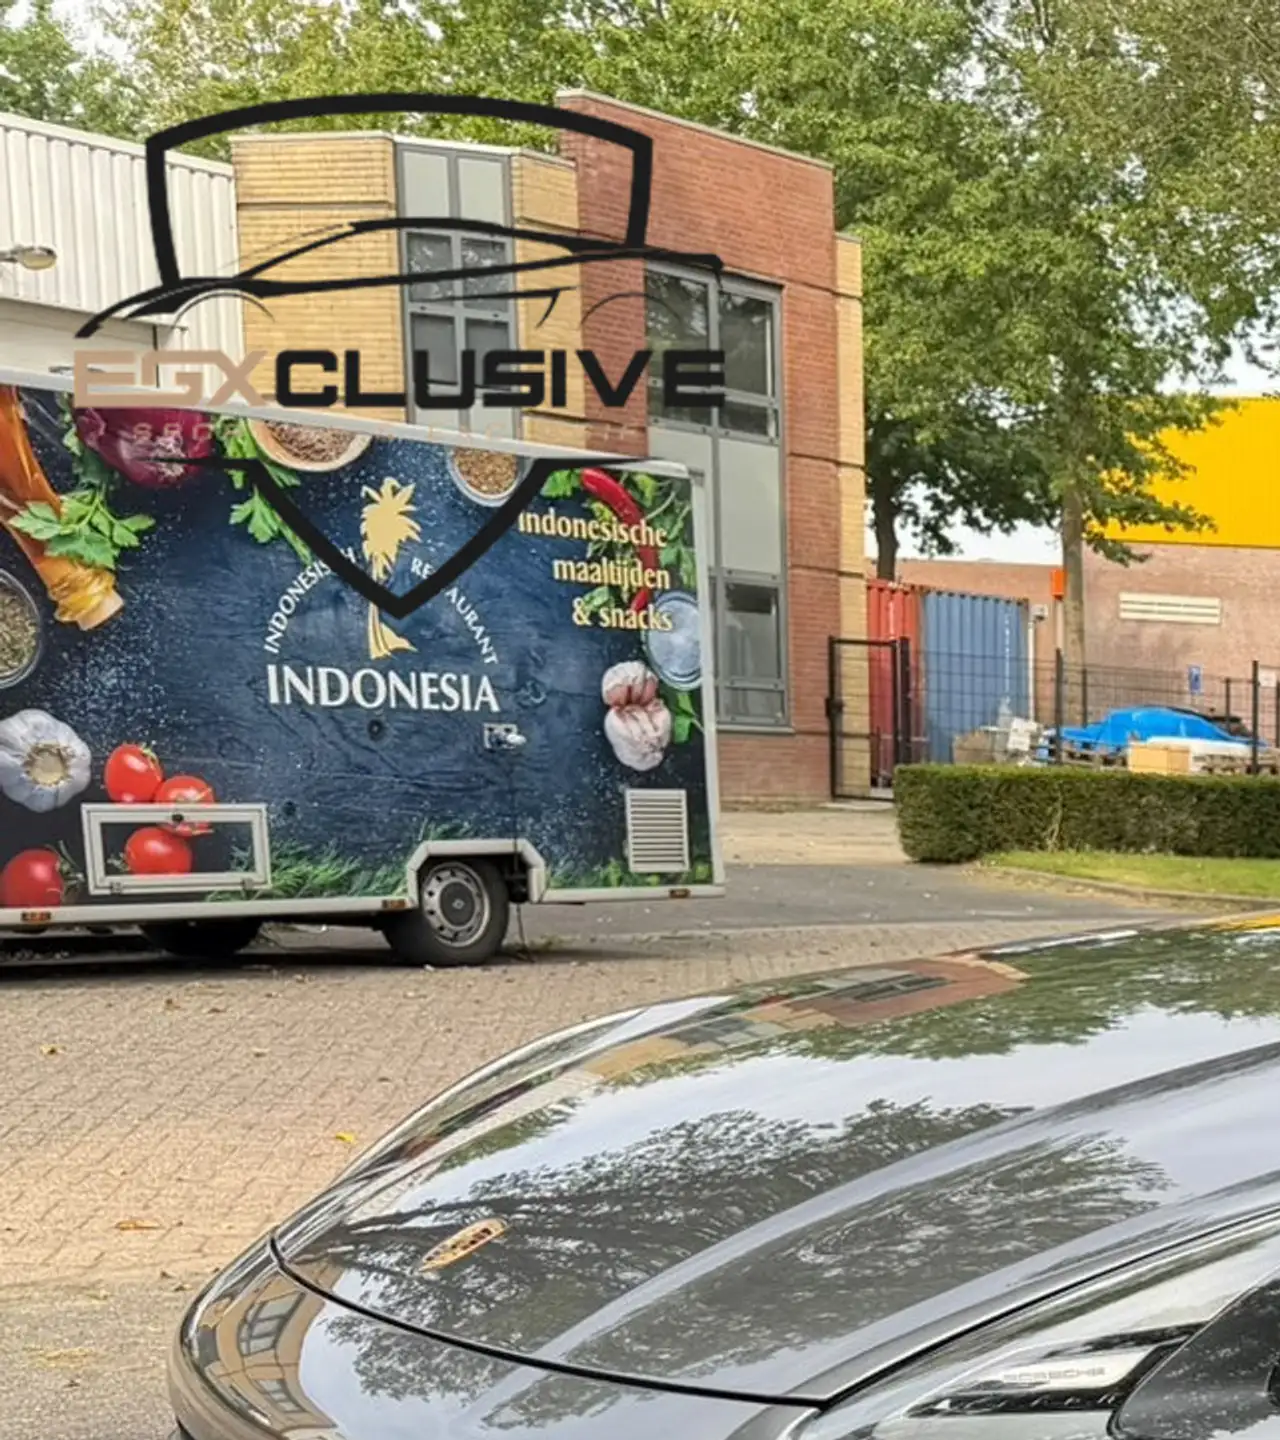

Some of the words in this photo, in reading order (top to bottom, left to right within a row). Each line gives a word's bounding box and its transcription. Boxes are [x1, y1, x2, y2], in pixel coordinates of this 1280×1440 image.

[518, 507, 667, 547] indonesische
[553, 557, 670, 591] maaltijden
[411, 557, 498, 665] REAURANT
[572, 597, 592, 625] &
[600, 604, 672, 631] snacks
[267, 664, 500, 712] INDONESIA
